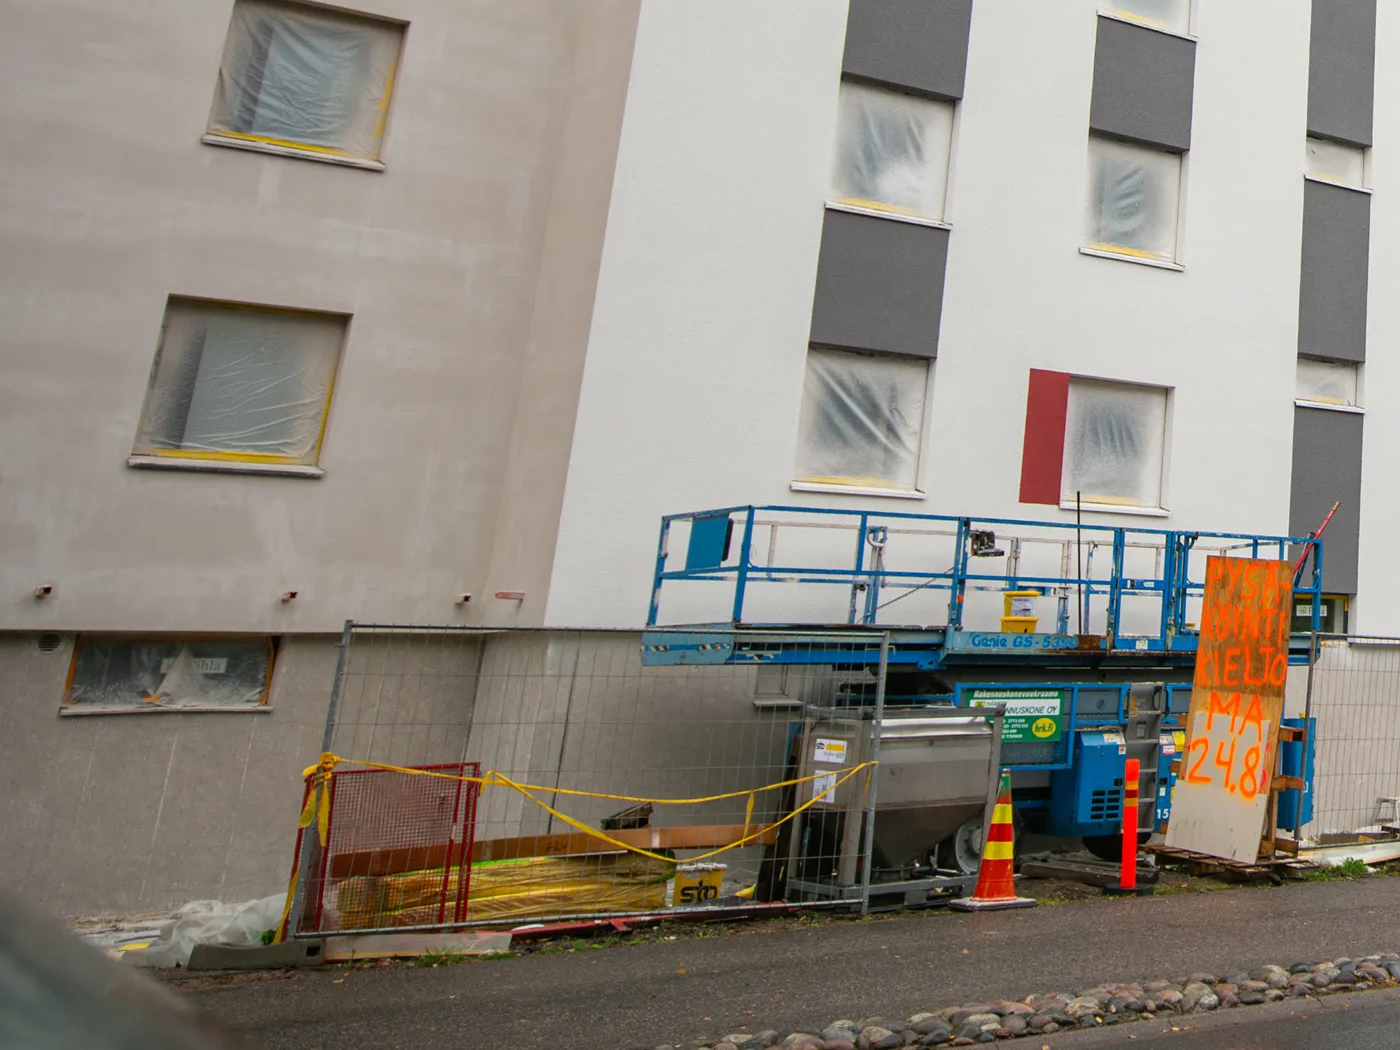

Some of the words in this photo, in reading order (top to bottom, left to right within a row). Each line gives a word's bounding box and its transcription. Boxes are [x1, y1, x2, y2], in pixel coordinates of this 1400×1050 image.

[1206, 557, 1293, 606] PYSÄ-
[971, 633, 1008, 648] Genie
[1202, 599, 1286, 648] KÖINTI
[1196, 643, 1287, 687] KIELTO
[1046, 706, 1058, 714] OY
[1206, 691, 1264, 743] MA
[1187, 736, 1261, 799] 24.8
[680, 880, 718, 903] sto
